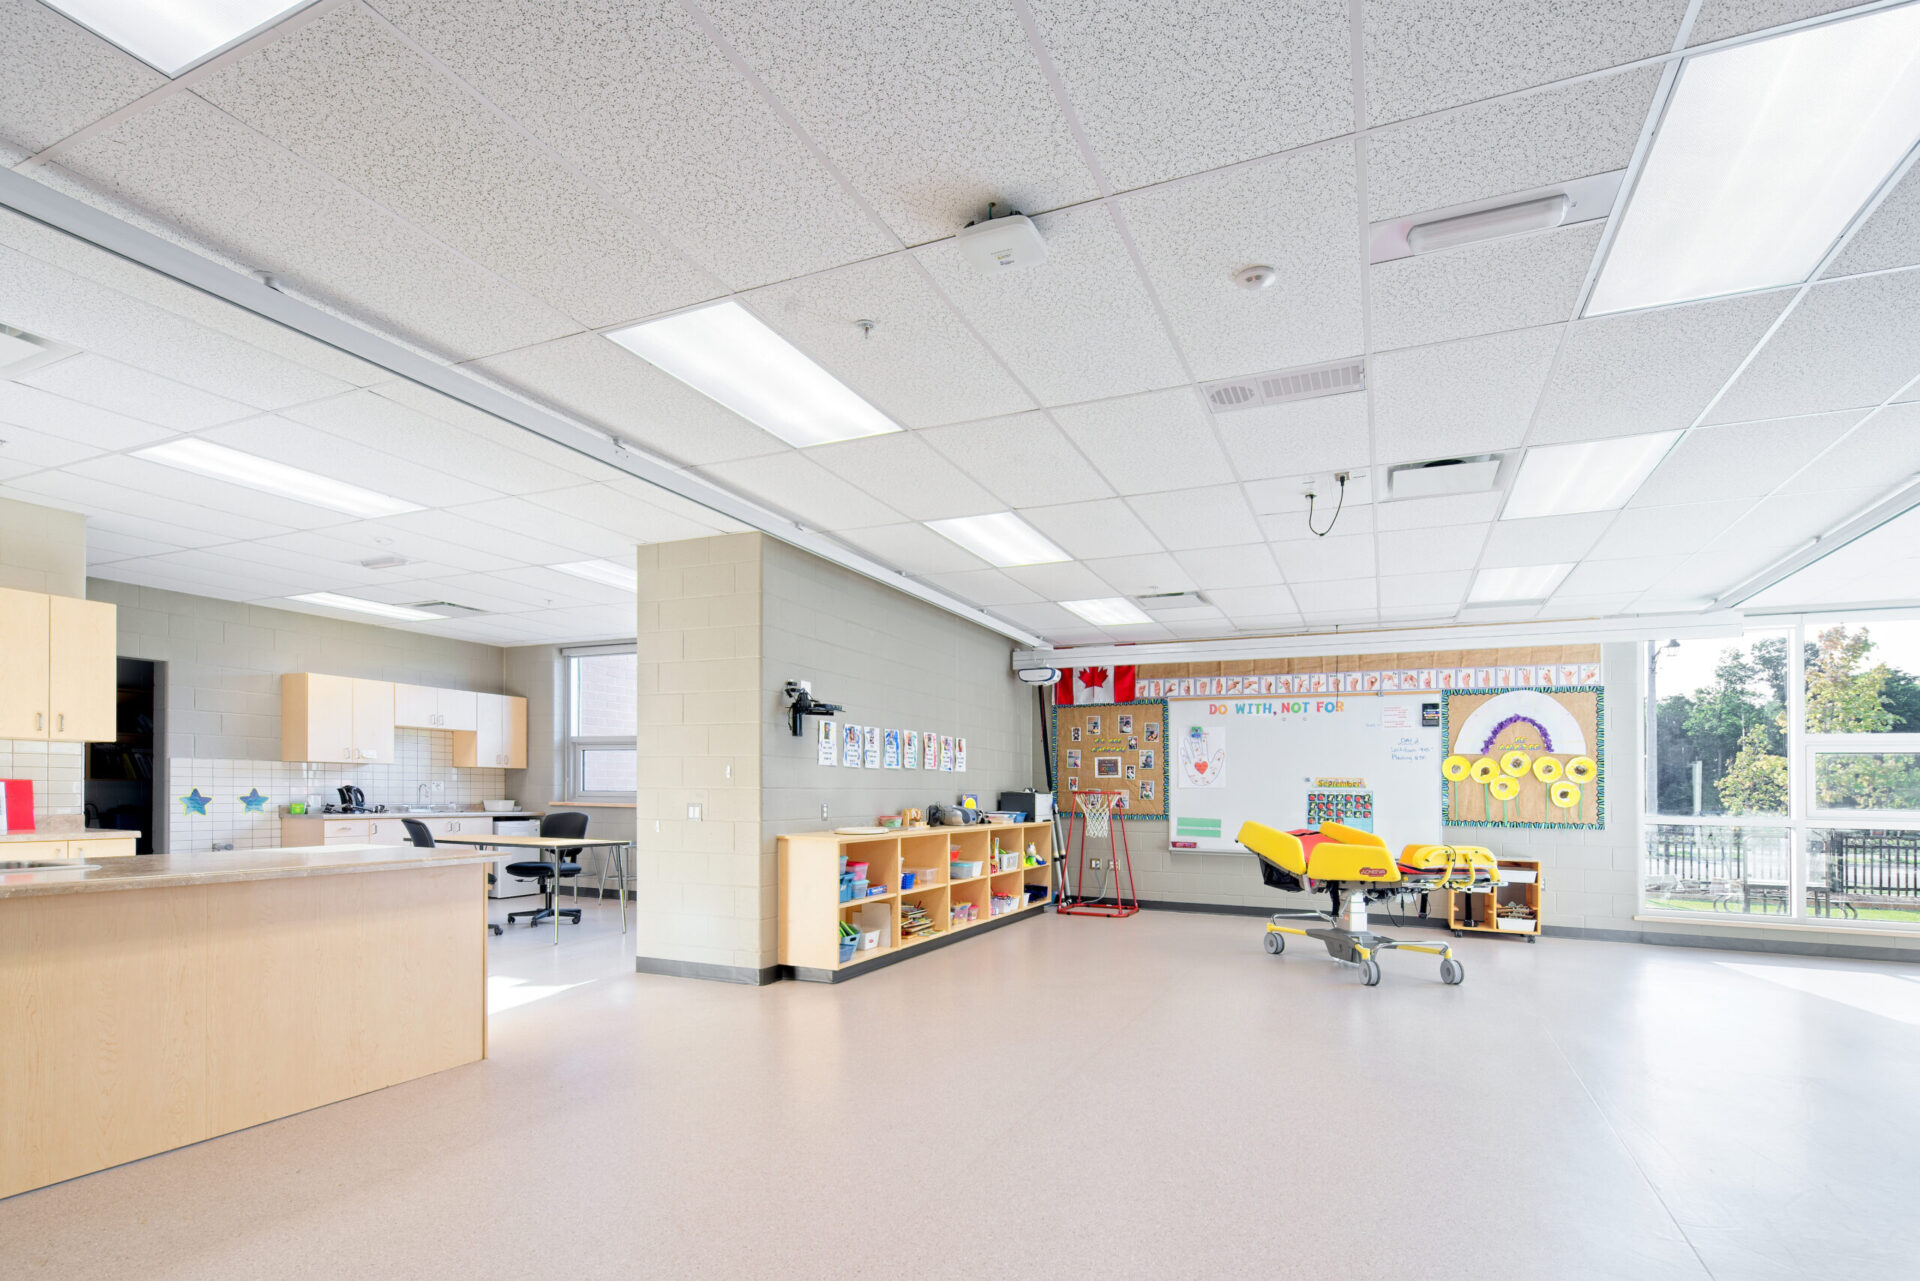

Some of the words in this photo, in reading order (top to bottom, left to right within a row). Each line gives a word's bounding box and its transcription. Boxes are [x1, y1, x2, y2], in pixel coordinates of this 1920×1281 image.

[1209, 703, 1228, 715] DO
[1235, 703, 1277, 716] WITH,
[1281, 702, 1310, 714] NOT
[1316, 701, 1345, 713] FOR
[1317, 779, 1362, 788] September
